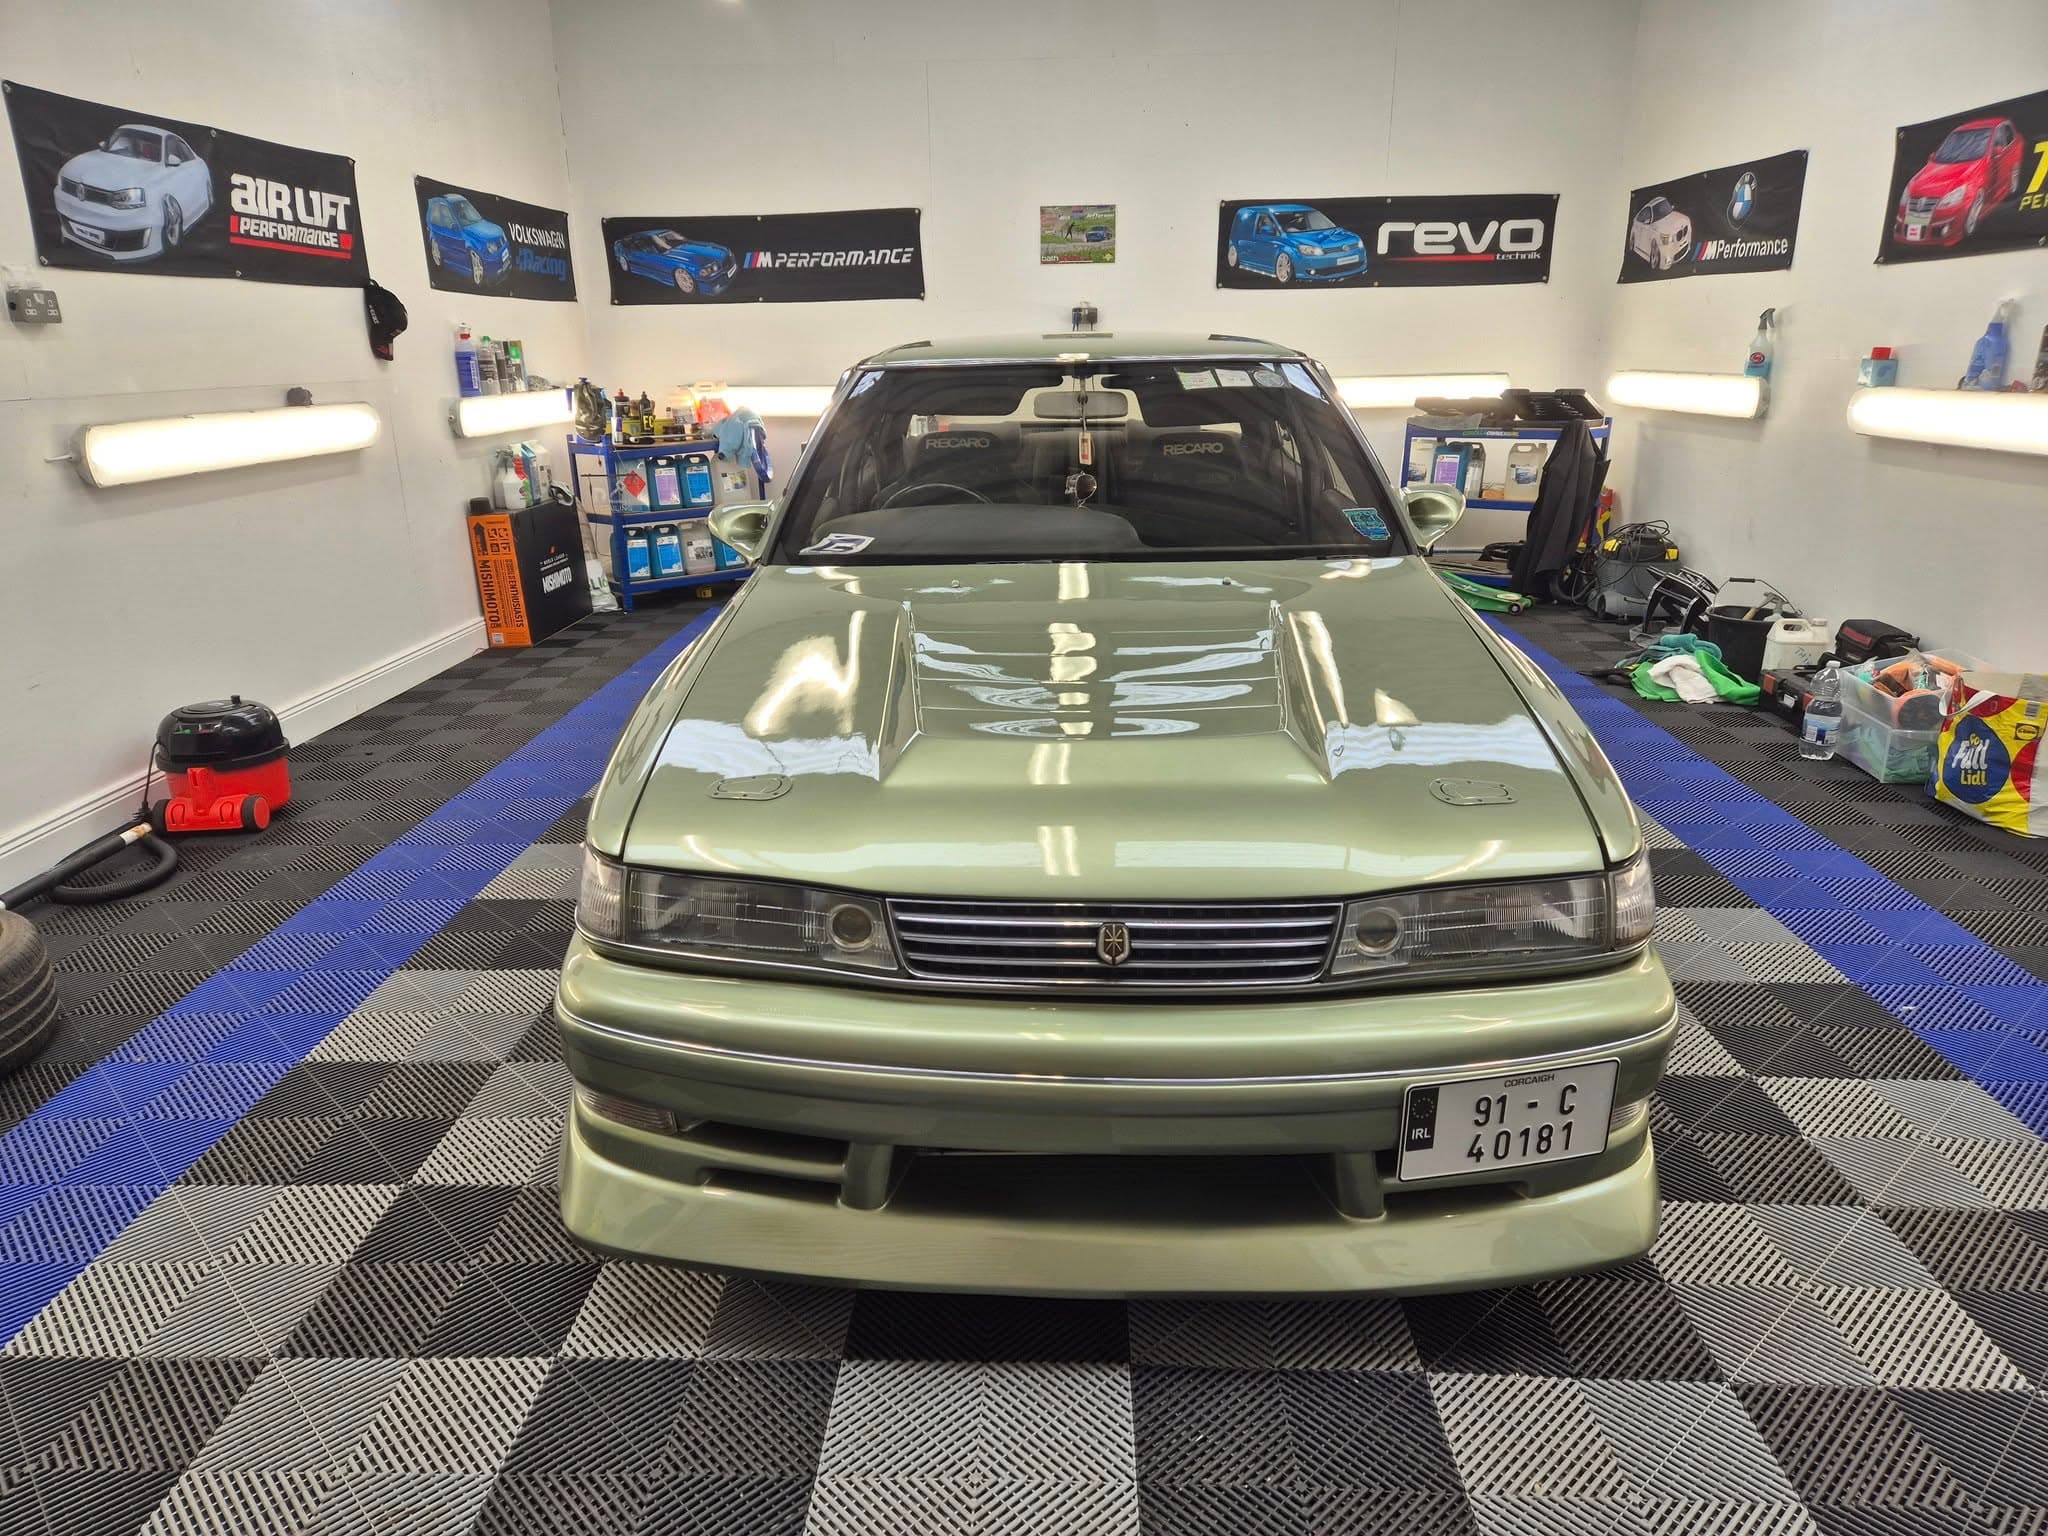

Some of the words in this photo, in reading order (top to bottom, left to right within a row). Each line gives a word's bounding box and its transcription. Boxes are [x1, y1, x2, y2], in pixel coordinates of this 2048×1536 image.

[294, 187, 351, 230] LIFT
[508, 222, 566, 248] VOLKSWAGEN
[1377, 219, 1544, 254] revo
[775, 248, 914, 268] PERFORMANCE
[1496, 252, 1541, 260] technik
[1716, 238, 1788, 259] Performance
[926, 438, 990, 449] RECARO
[1163, 442, 1224, 455] RECARO
[479, 560, 500, 622] MISHIMOTO
[508, 581, 525, 628] ENTHUSIASTS
[1504, 1073, 1555, 1088] CORCAIGH
[1473, 1094, 1508, 1127] 91
[1559, 1084, 1577, 1115] C
[1411, 1127, 1431, 1140] IRL
[1467, 1120, 1573, 1163] 40181
